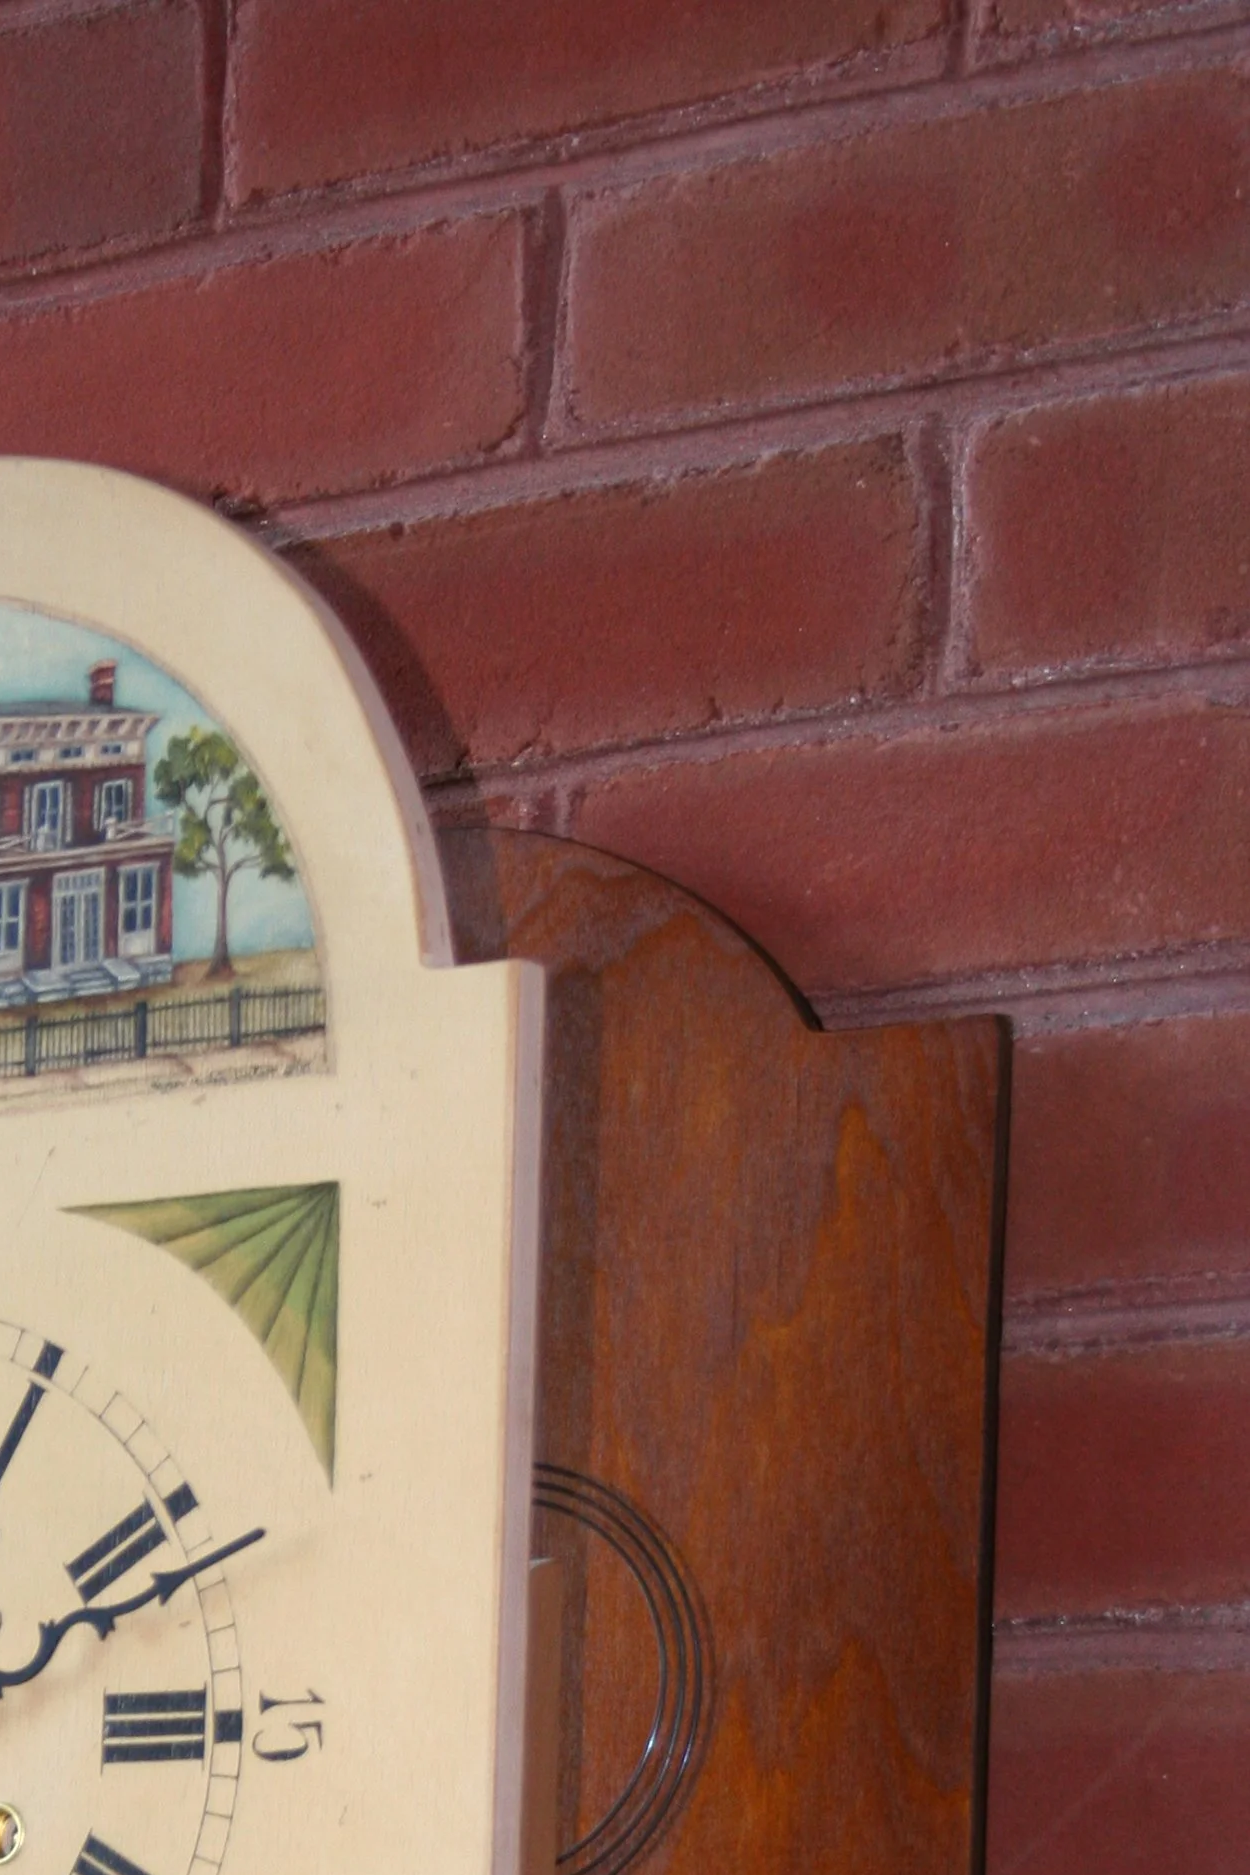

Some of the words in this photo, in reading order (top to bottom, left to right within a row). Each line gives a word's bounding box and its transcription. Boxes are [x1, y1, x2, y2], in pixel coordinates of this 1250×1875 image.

[62, 1490, 171, 1608] II
[100, 1680, 207, 1777] III
[251, 1688, 326, 1762] 15
